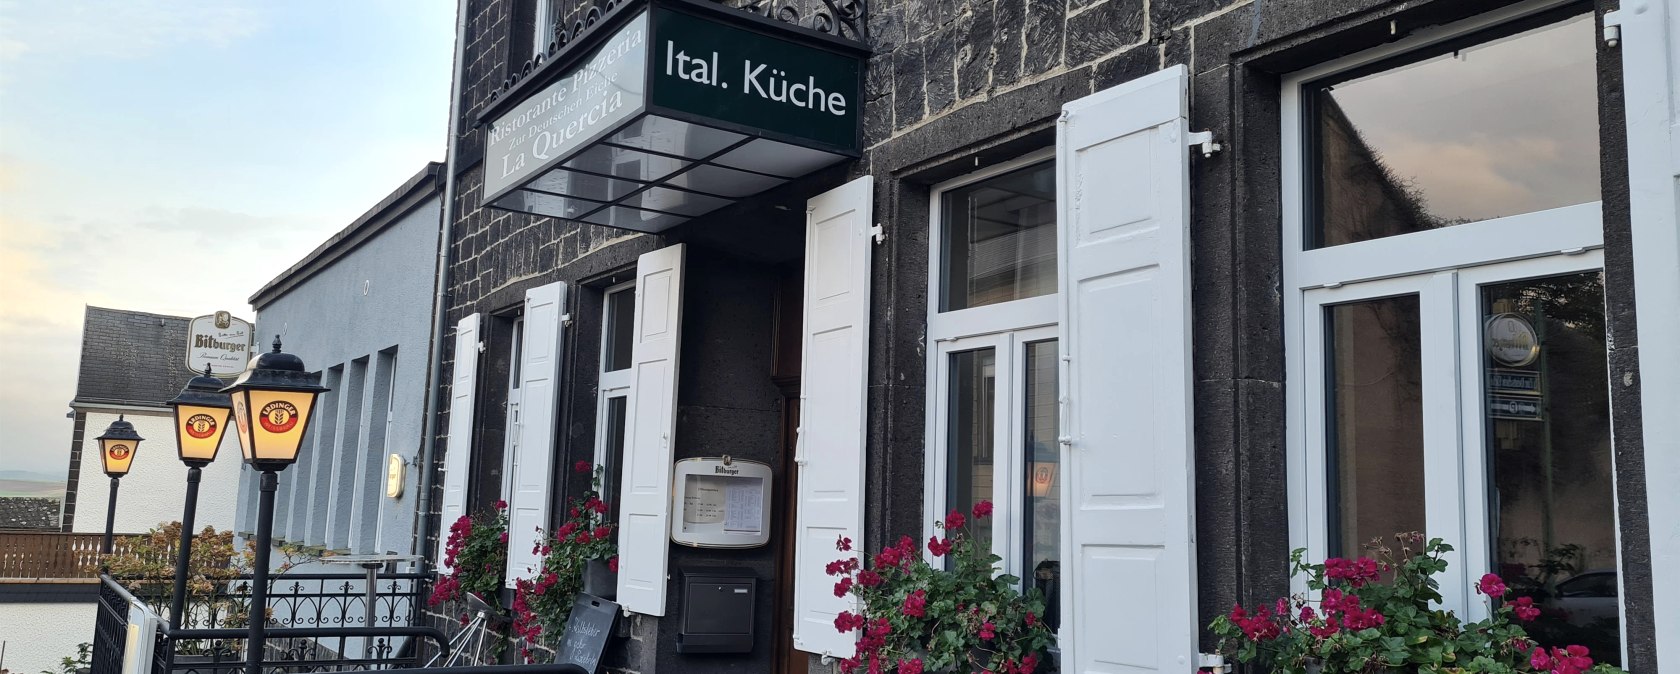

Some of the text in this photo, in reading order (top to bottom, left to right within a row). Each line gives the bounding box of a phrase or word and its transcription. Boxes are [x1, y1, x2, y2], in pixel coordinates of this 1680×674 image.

[489, 28, 642, 147] Ristorante Pizzeria
[666, 39, 846, 116] Ital. Küche
[500, 89, 623, 180] La Quercia
[508, 72, 618, 151] Zur Deutschen Eiche
[194, 334, 246, 353] Bitburger
[188, 415, 215, 426] ERDINGER
[262, 402, 296, 416] ERDINGER
[715, 465, 739, 475] Bitburger
